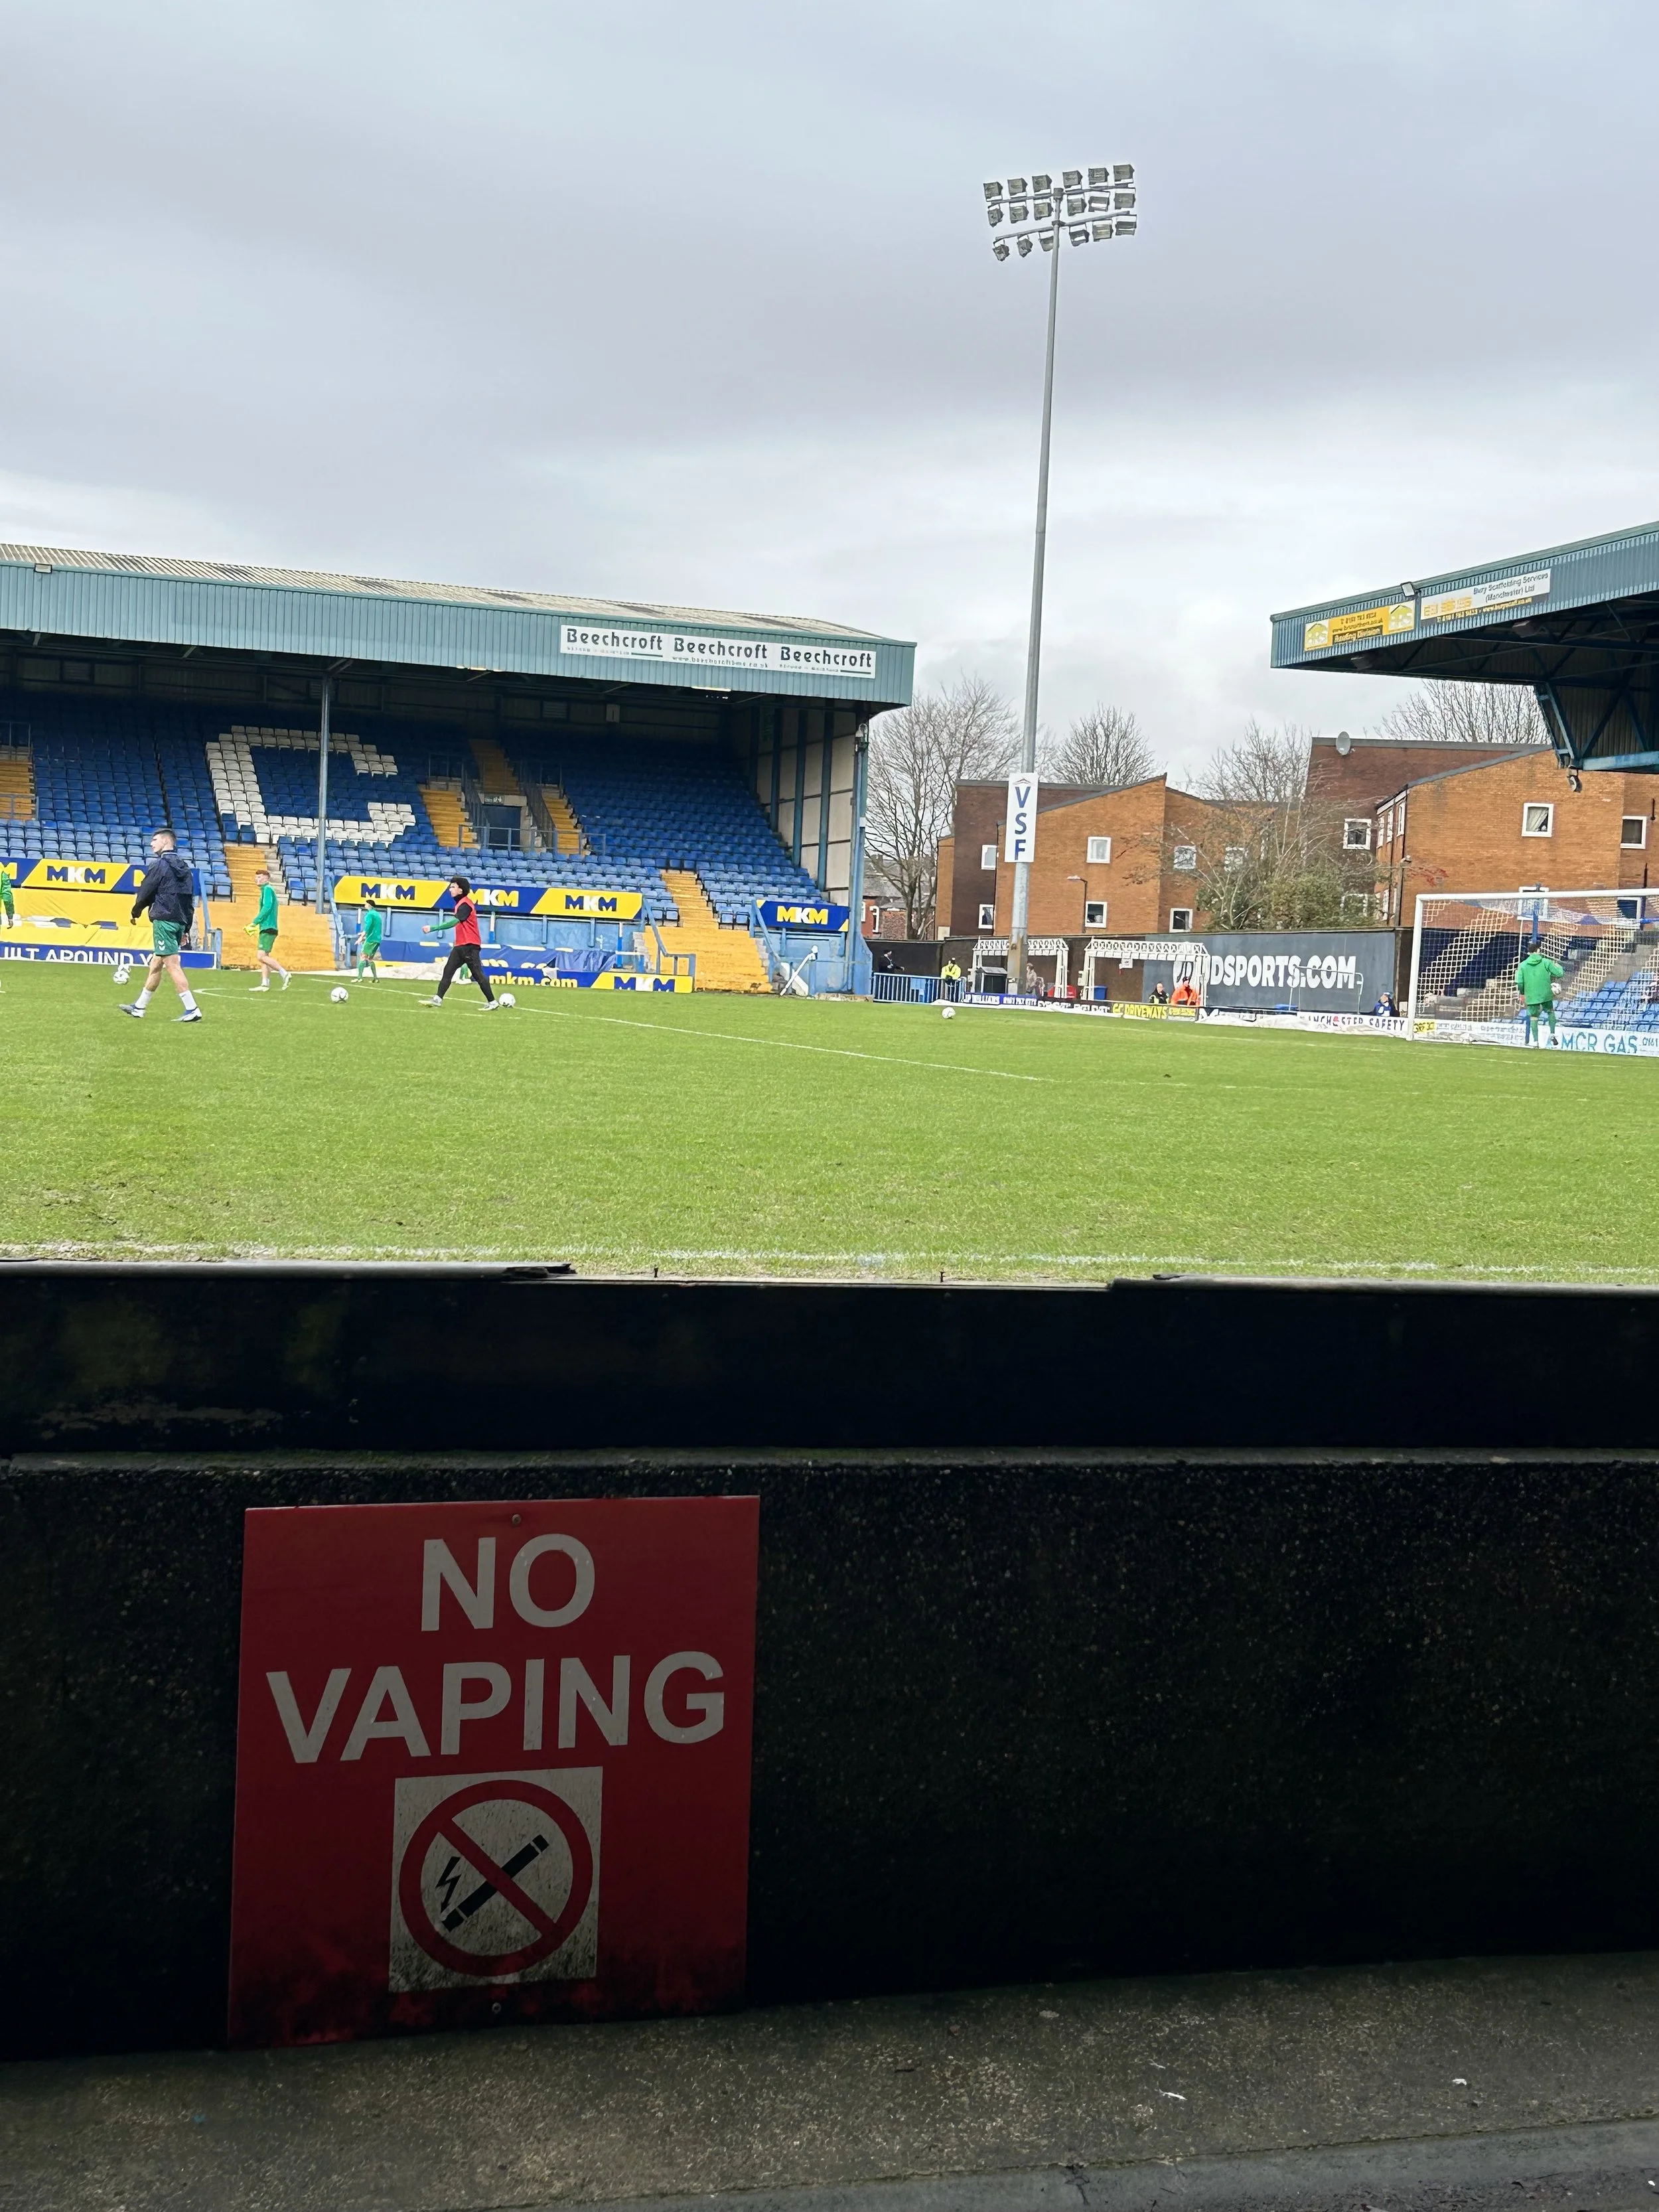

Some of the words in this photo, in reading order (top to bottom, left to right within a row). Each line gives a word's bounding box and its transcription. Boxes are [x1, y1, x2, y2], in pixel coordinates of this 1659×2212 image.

[567, 628, 662, 650] Beechcroft
[674, 637, 767, 659] Beechcroft
[780, 646, 871, 668] Beechcroft
[1015, 786, 1031, 861] VSF
[46, 865, 106, 884] MKM
[360, 883, 416, 901] MKM
[565, 895, 617, 912] MKM
[776, 906, 829, 925] MKM
[489, 972, 578, 988] mkm.com
[614, 976, 676, 992] MKM
[1125, 1003, 1168, 1019] DRIVEWAYS
[1561, 1031, 1598, 1052] MCR
[1604, 1033, 1638, 1054] GAS
[420, 1533, 596, 1632] NO
[266, 1651, 725, 1764] VAPING
